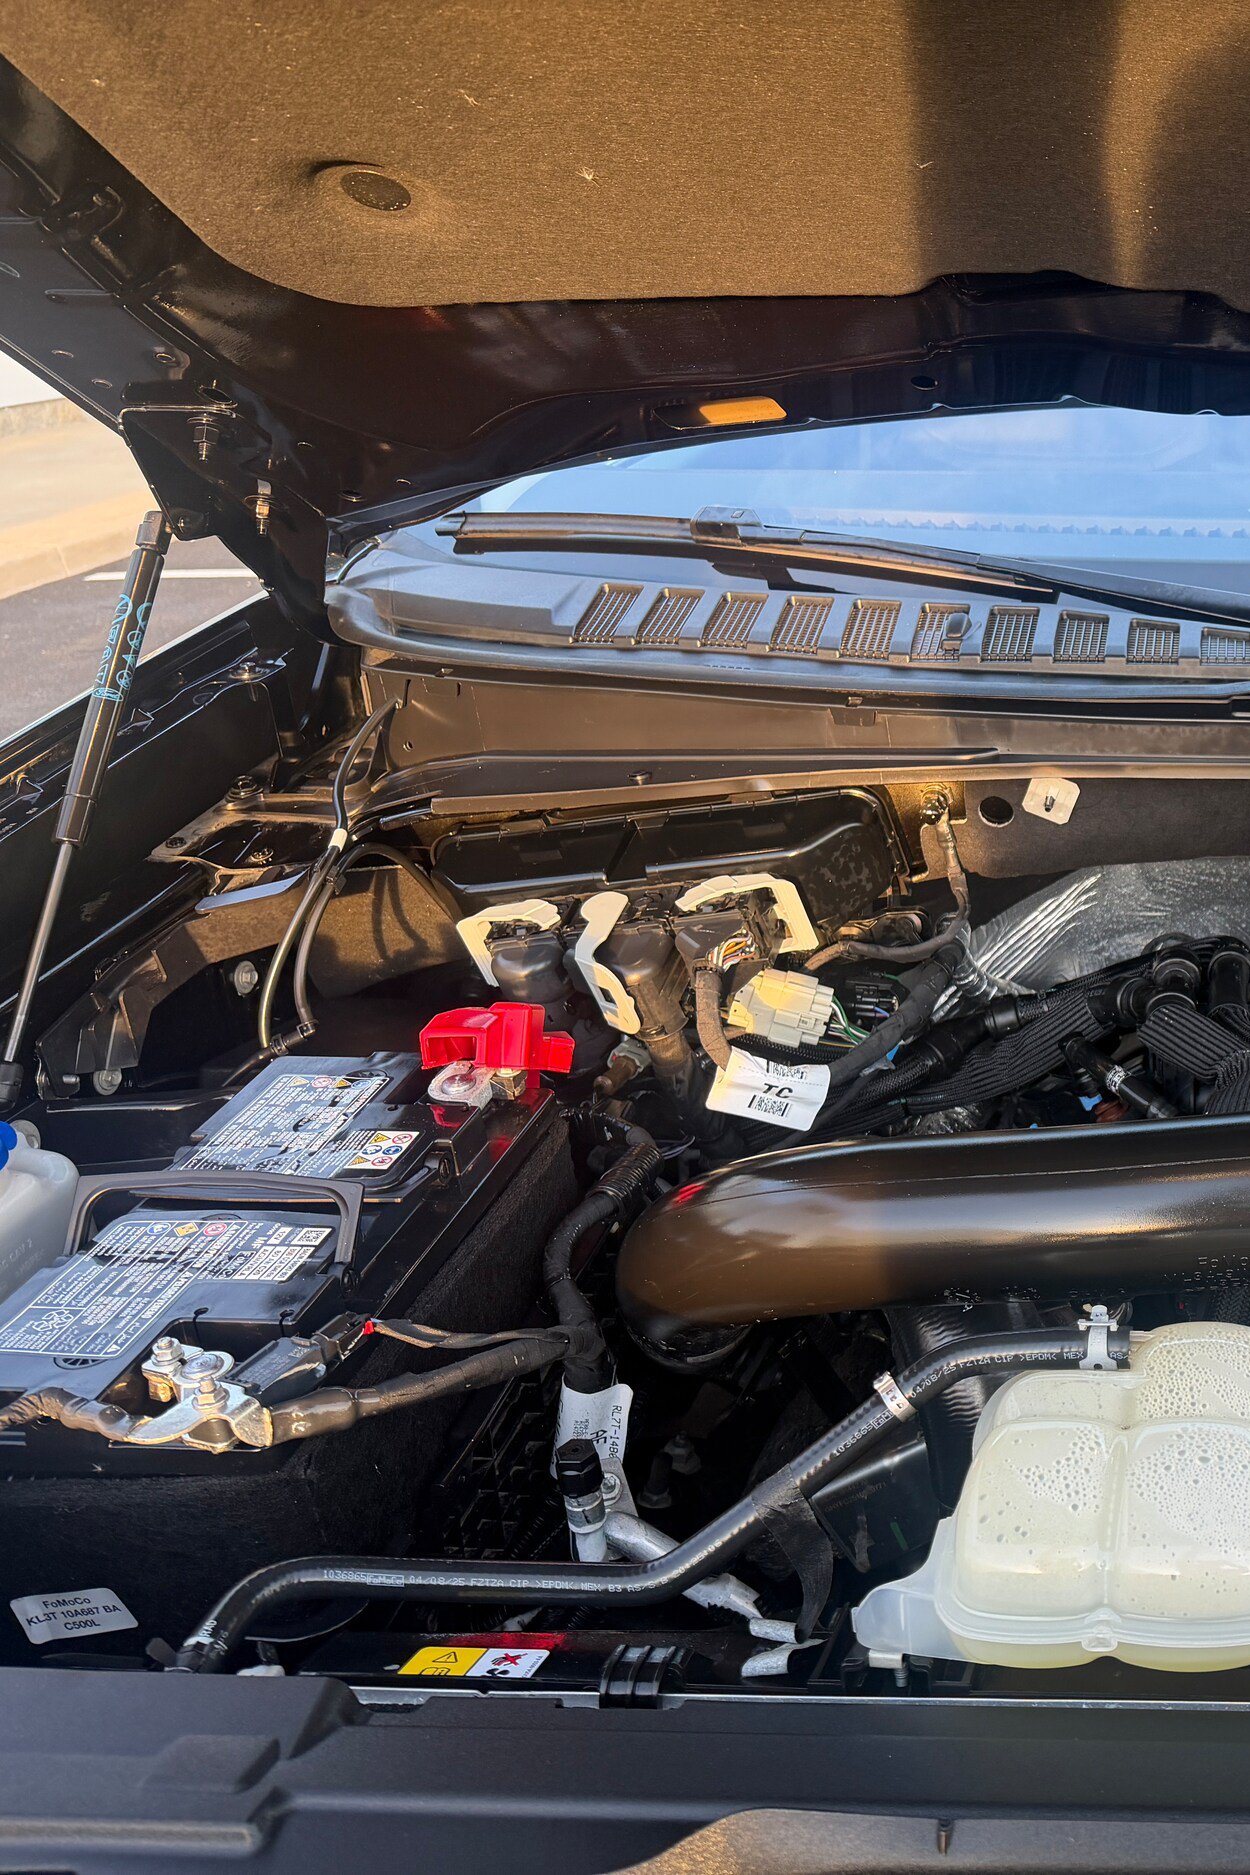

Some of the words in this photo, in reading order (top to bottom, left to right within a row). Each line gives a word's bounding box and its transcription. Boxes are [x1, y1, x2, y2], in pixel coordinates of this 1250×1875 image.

[762, 1082, 794, 1099] TC
[833, 1422, 873, 1457] 1036865
[1020, 1353, 1057, 1362] >EPDM<
[1063, 1351, 1085, 1360] MEX
[323, 1570, 367, 1582] 1036865
[409, 1575, 466, 1586] 04/08/25
[581, 1582, 602, 1592] MEX
[42, 1597, 91, 1609] FoMoCo
[26, 1612, 58, 1626] KL3T
[60, 1606, 100, 1619] 10A687
[102, 1604, 122, 1613] BA
[63, 1619, 101, 1631] C500L
